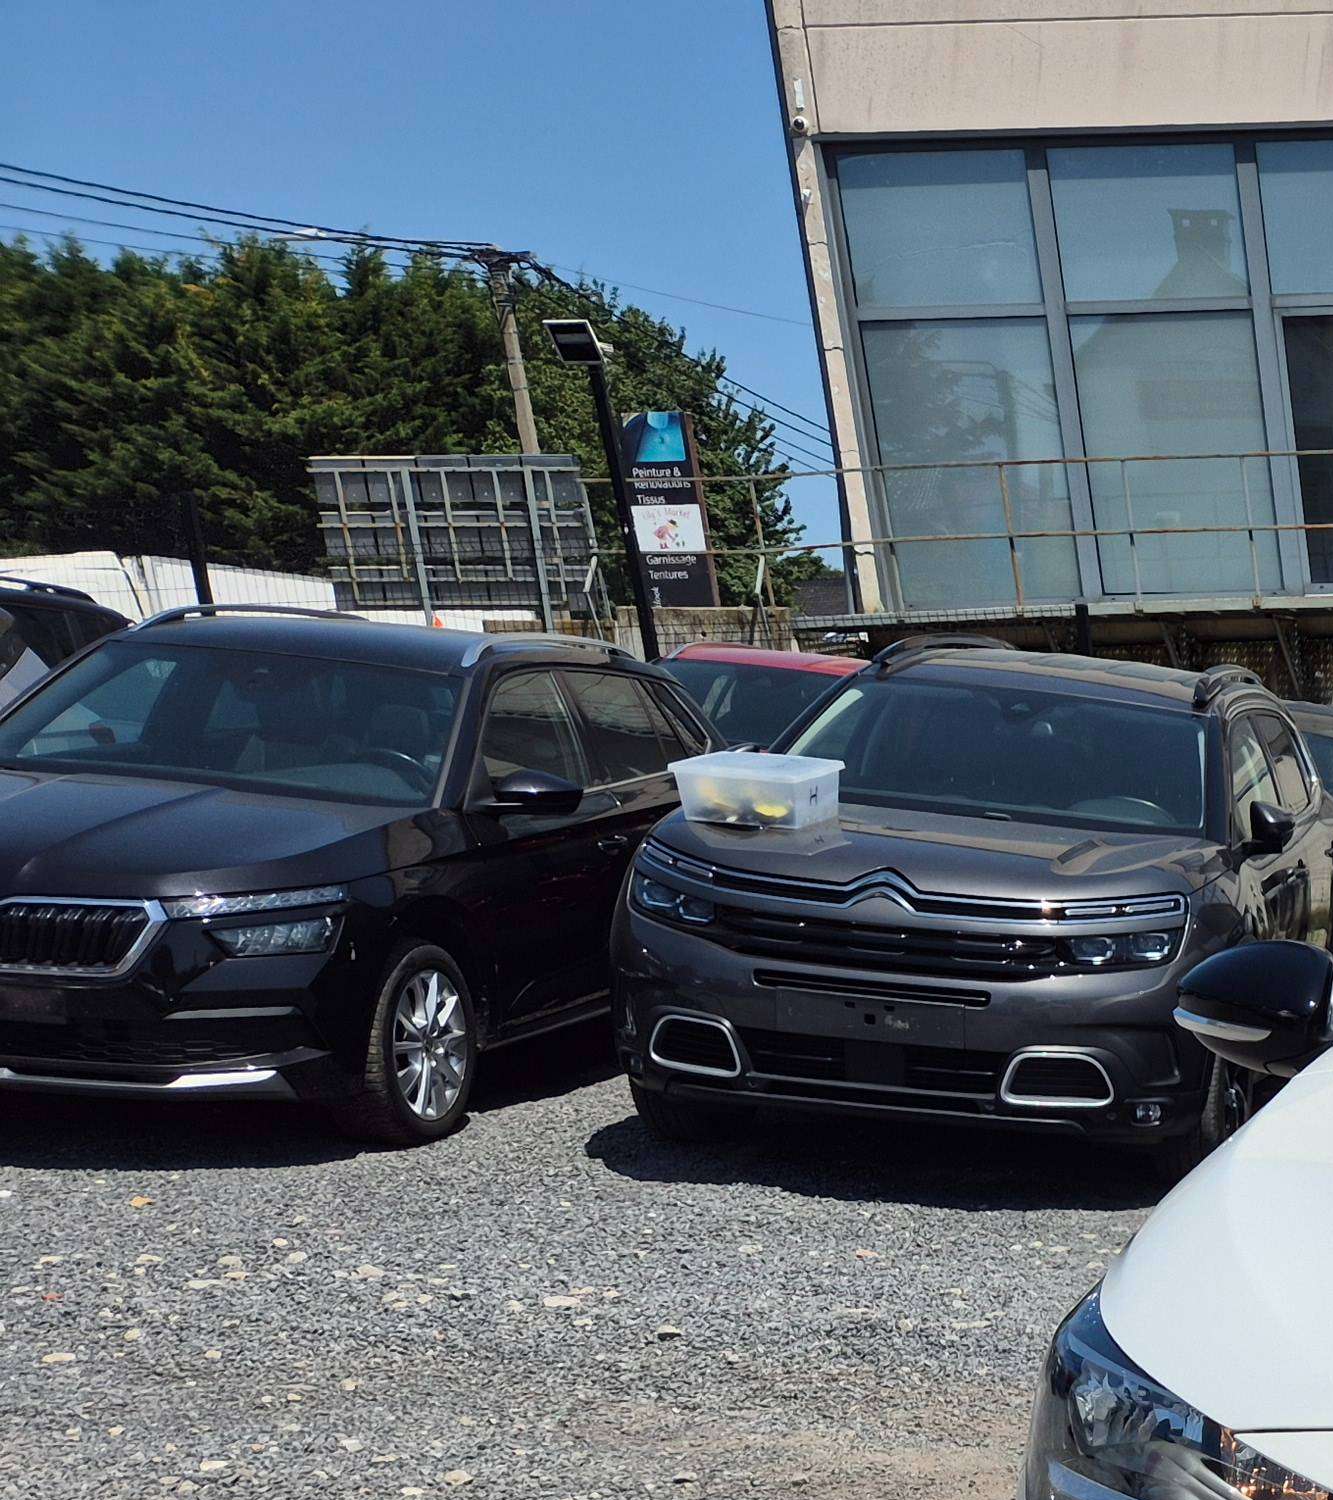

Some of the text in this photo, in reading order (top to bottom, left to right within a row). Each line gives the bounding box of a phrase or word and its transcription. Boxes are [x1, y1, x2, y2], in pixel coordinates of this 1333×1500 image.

[632, 466, 681, 478] Peinture &
[636, 495, 666, 505] Tissus
[646, 554, 697, 566] Garnissage
[648, 570, 689, 580] Tentures
